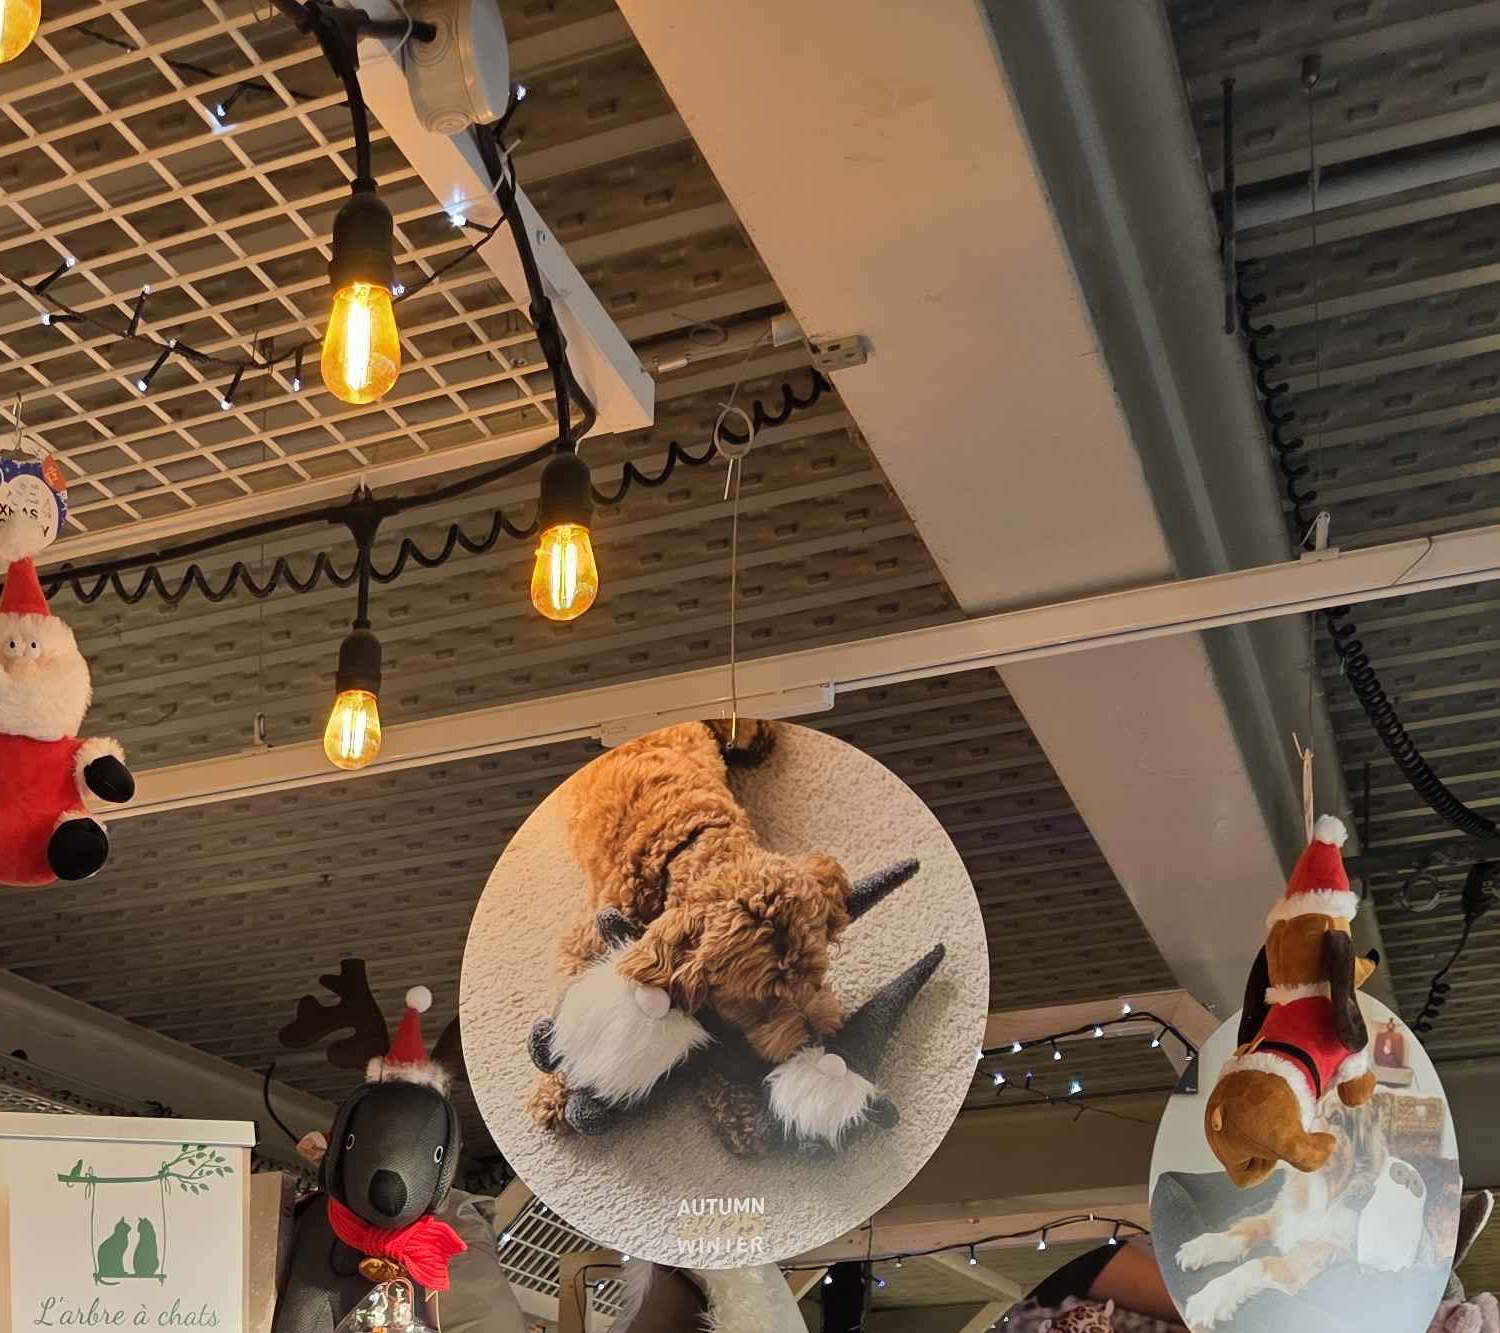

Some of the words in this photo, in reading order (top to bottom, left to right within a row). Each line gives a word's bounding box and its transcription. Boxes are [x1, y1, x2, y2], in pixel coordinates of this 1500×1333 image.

[676, 1197, 765, 1216] AUTUMN
[677, 1236, 764, 1254] WINTER
[34, 1296, 126, 1327] L'arbre
[133, 1303, 150, 1326] à
[158, 1298, 222, 1327] chats
